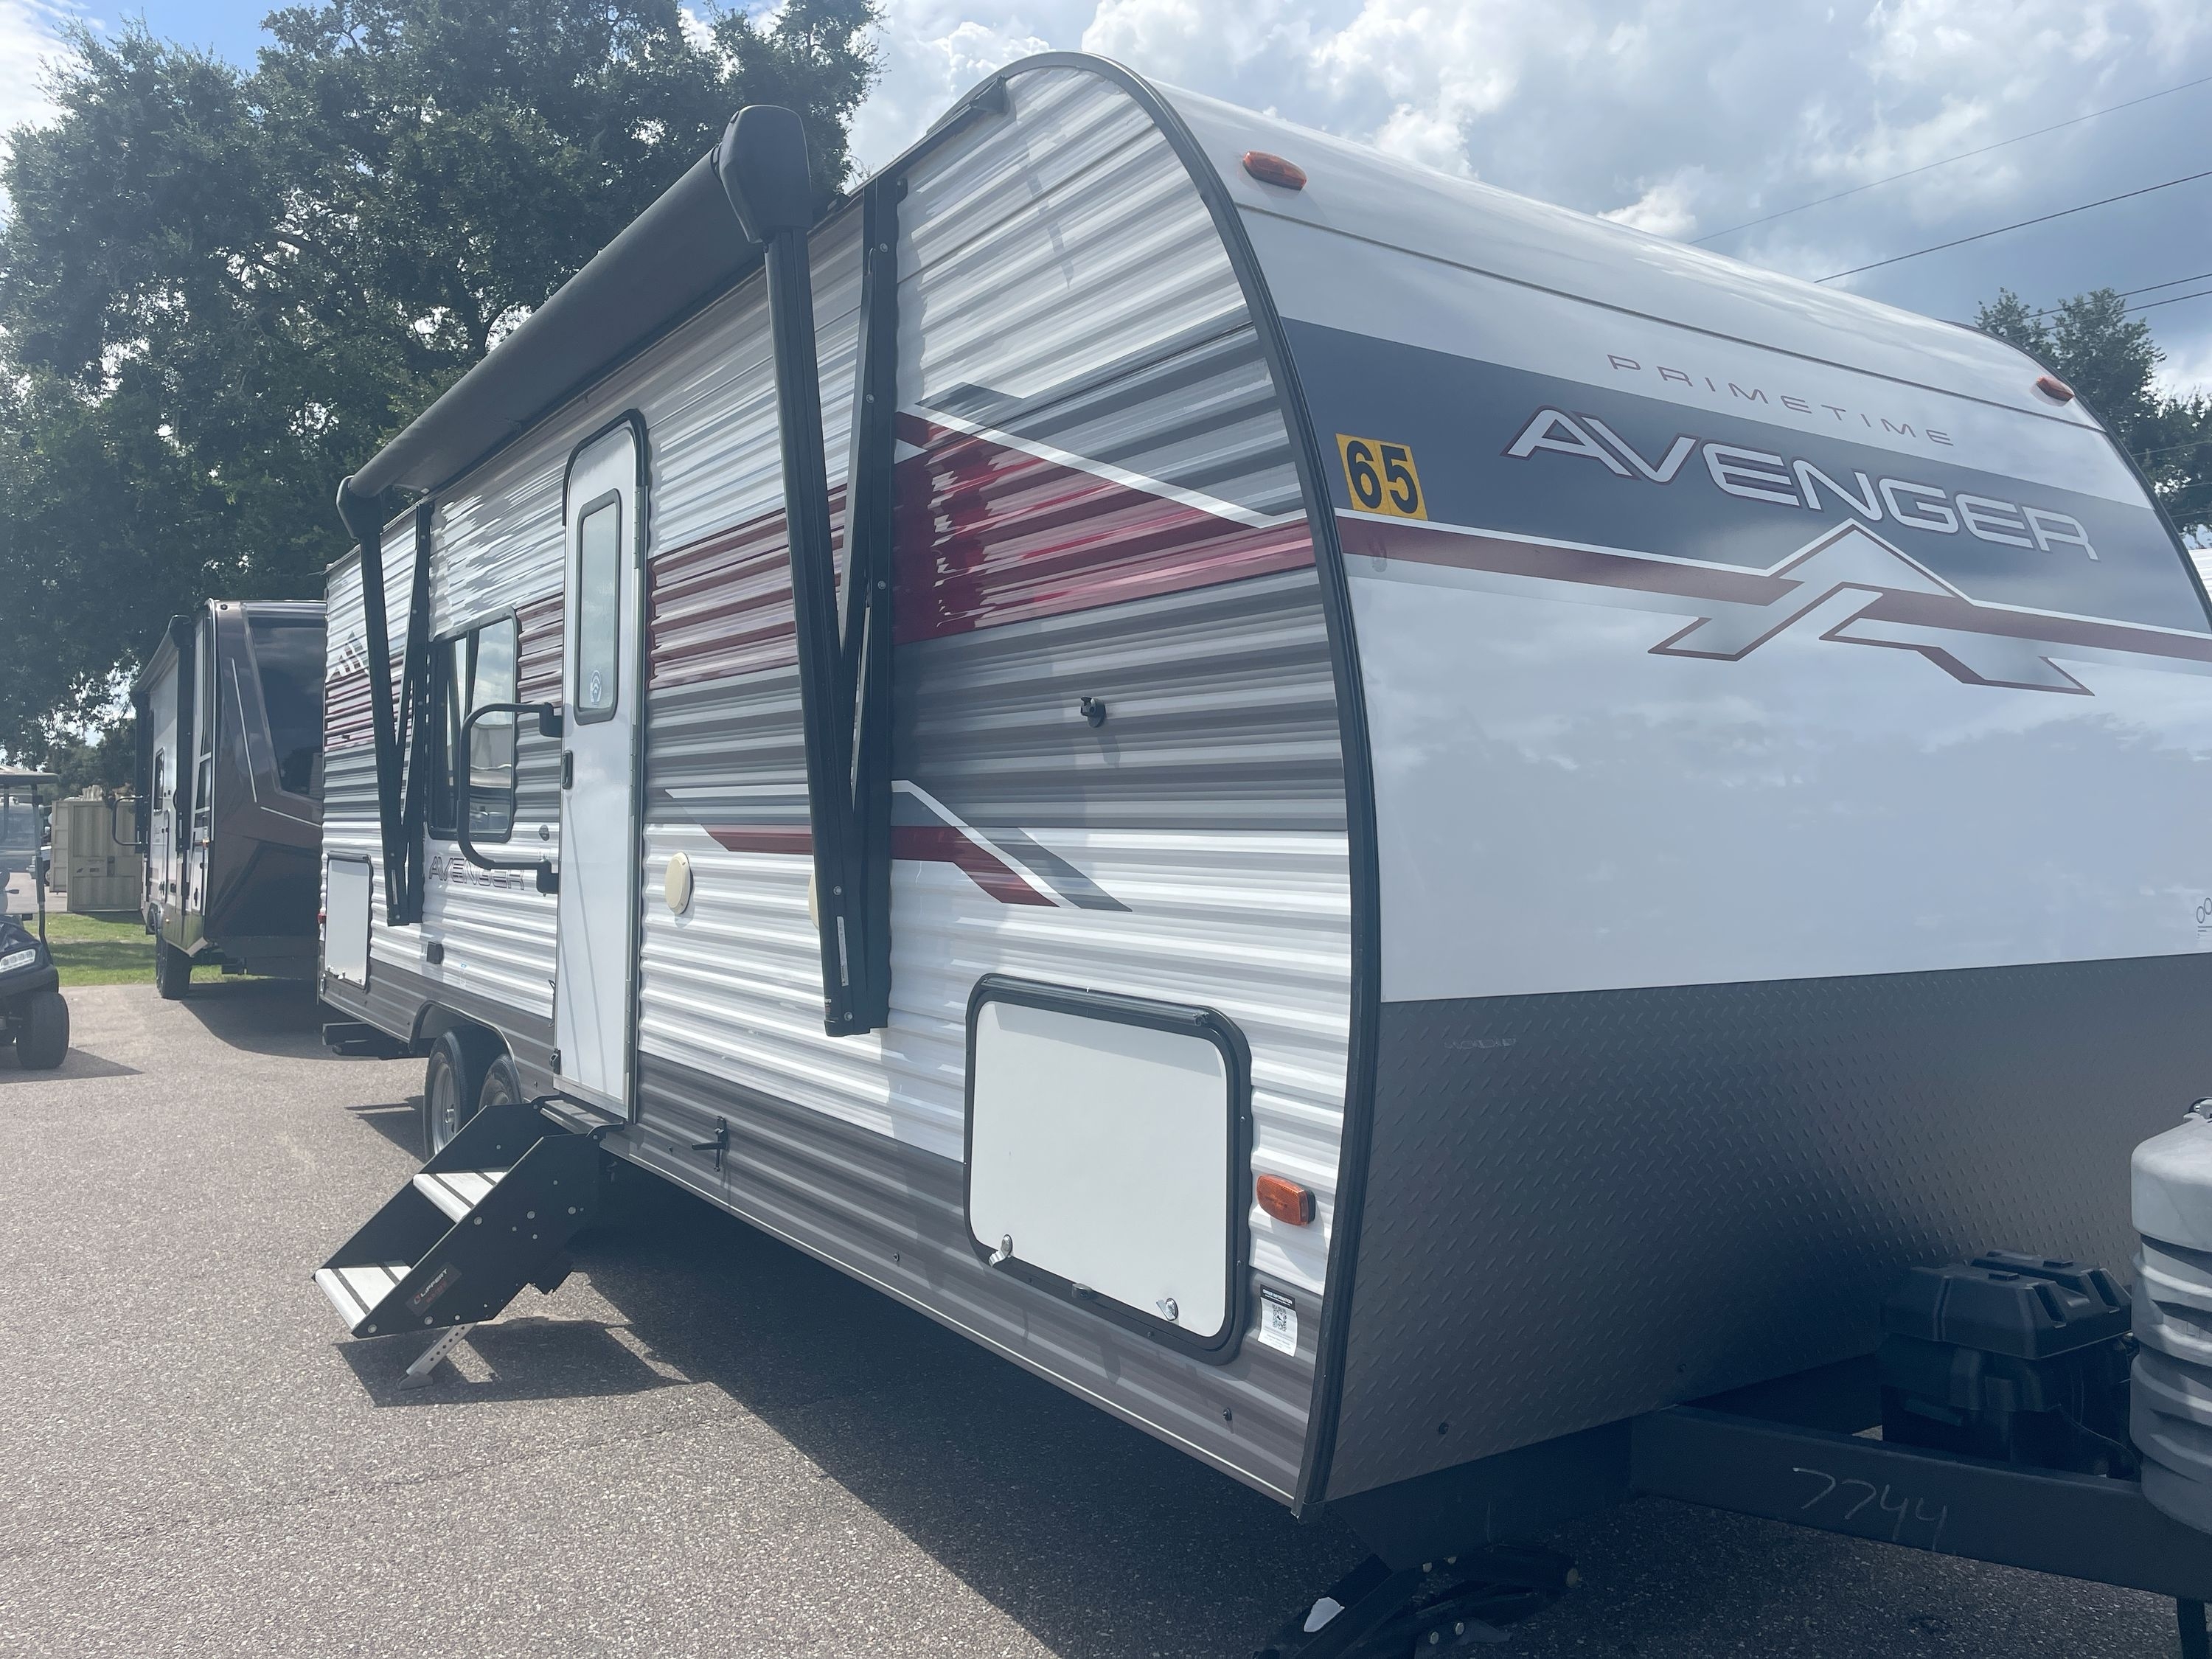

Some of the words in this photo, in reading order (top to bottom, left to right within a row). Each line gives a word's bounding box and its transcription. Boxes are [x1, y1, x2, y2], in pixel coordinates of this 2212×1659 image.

[1607, 353, 1954, 447] PRIMETIME
[1346, 440, 1419, 514] 65
[1500, 405, 2100, 562] AVENGER
[428, 855, 525, 891] AVENGER
[420, 1268, 448, 1298] LIPPERT
[1792, 1467, 1948, 1552] 7744
